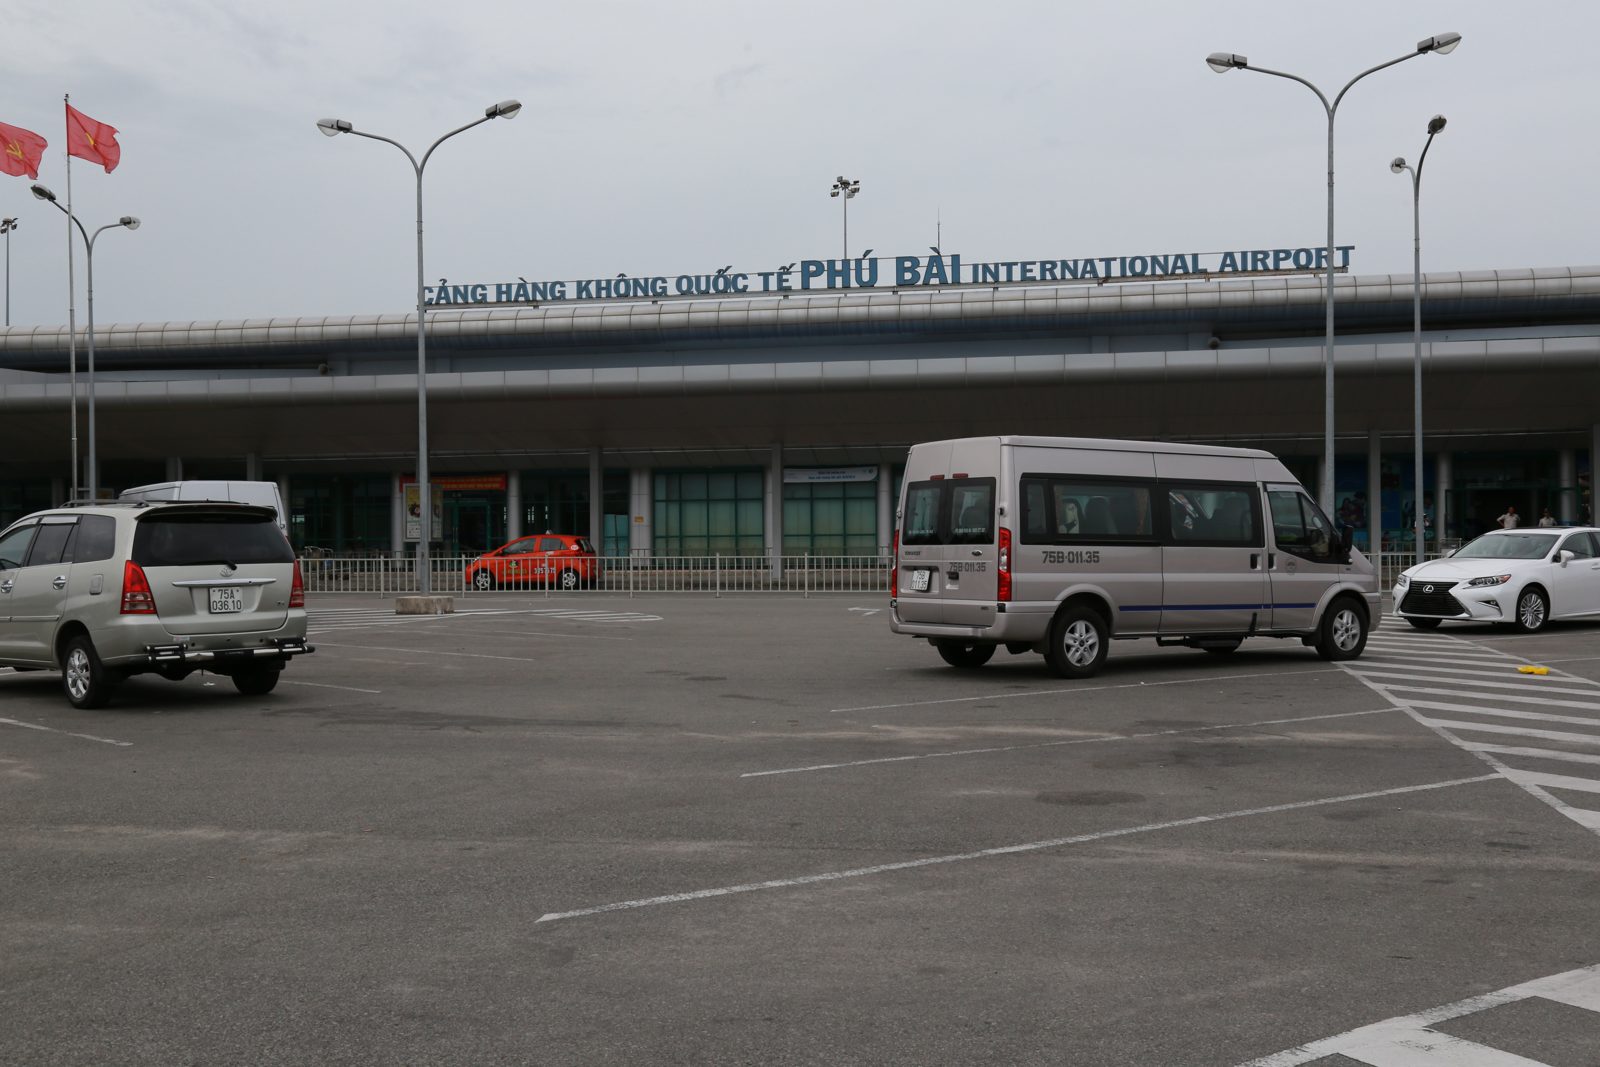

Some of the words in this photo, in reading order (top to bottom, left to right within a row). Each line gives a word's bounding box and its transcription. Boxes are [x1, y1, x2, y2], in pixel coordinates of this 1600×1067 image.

[496, 277, 567, 303] HÀNG
[576, 273, 668, 299] KHÔNG
[675, 265, 749, 295] QUỐC
[757, 263, 796, 293] TẾ
[800, 249, 878, 290] PHÚ
[895, 246, 960, 286] BÀI
[972, 253, 1207, 285] INTERNATIONAL
[1218, 245, 1355, 273] AIRPORT
[217, 588, 235, 600] 75A
[212, 600, 242, 611] 036.10
